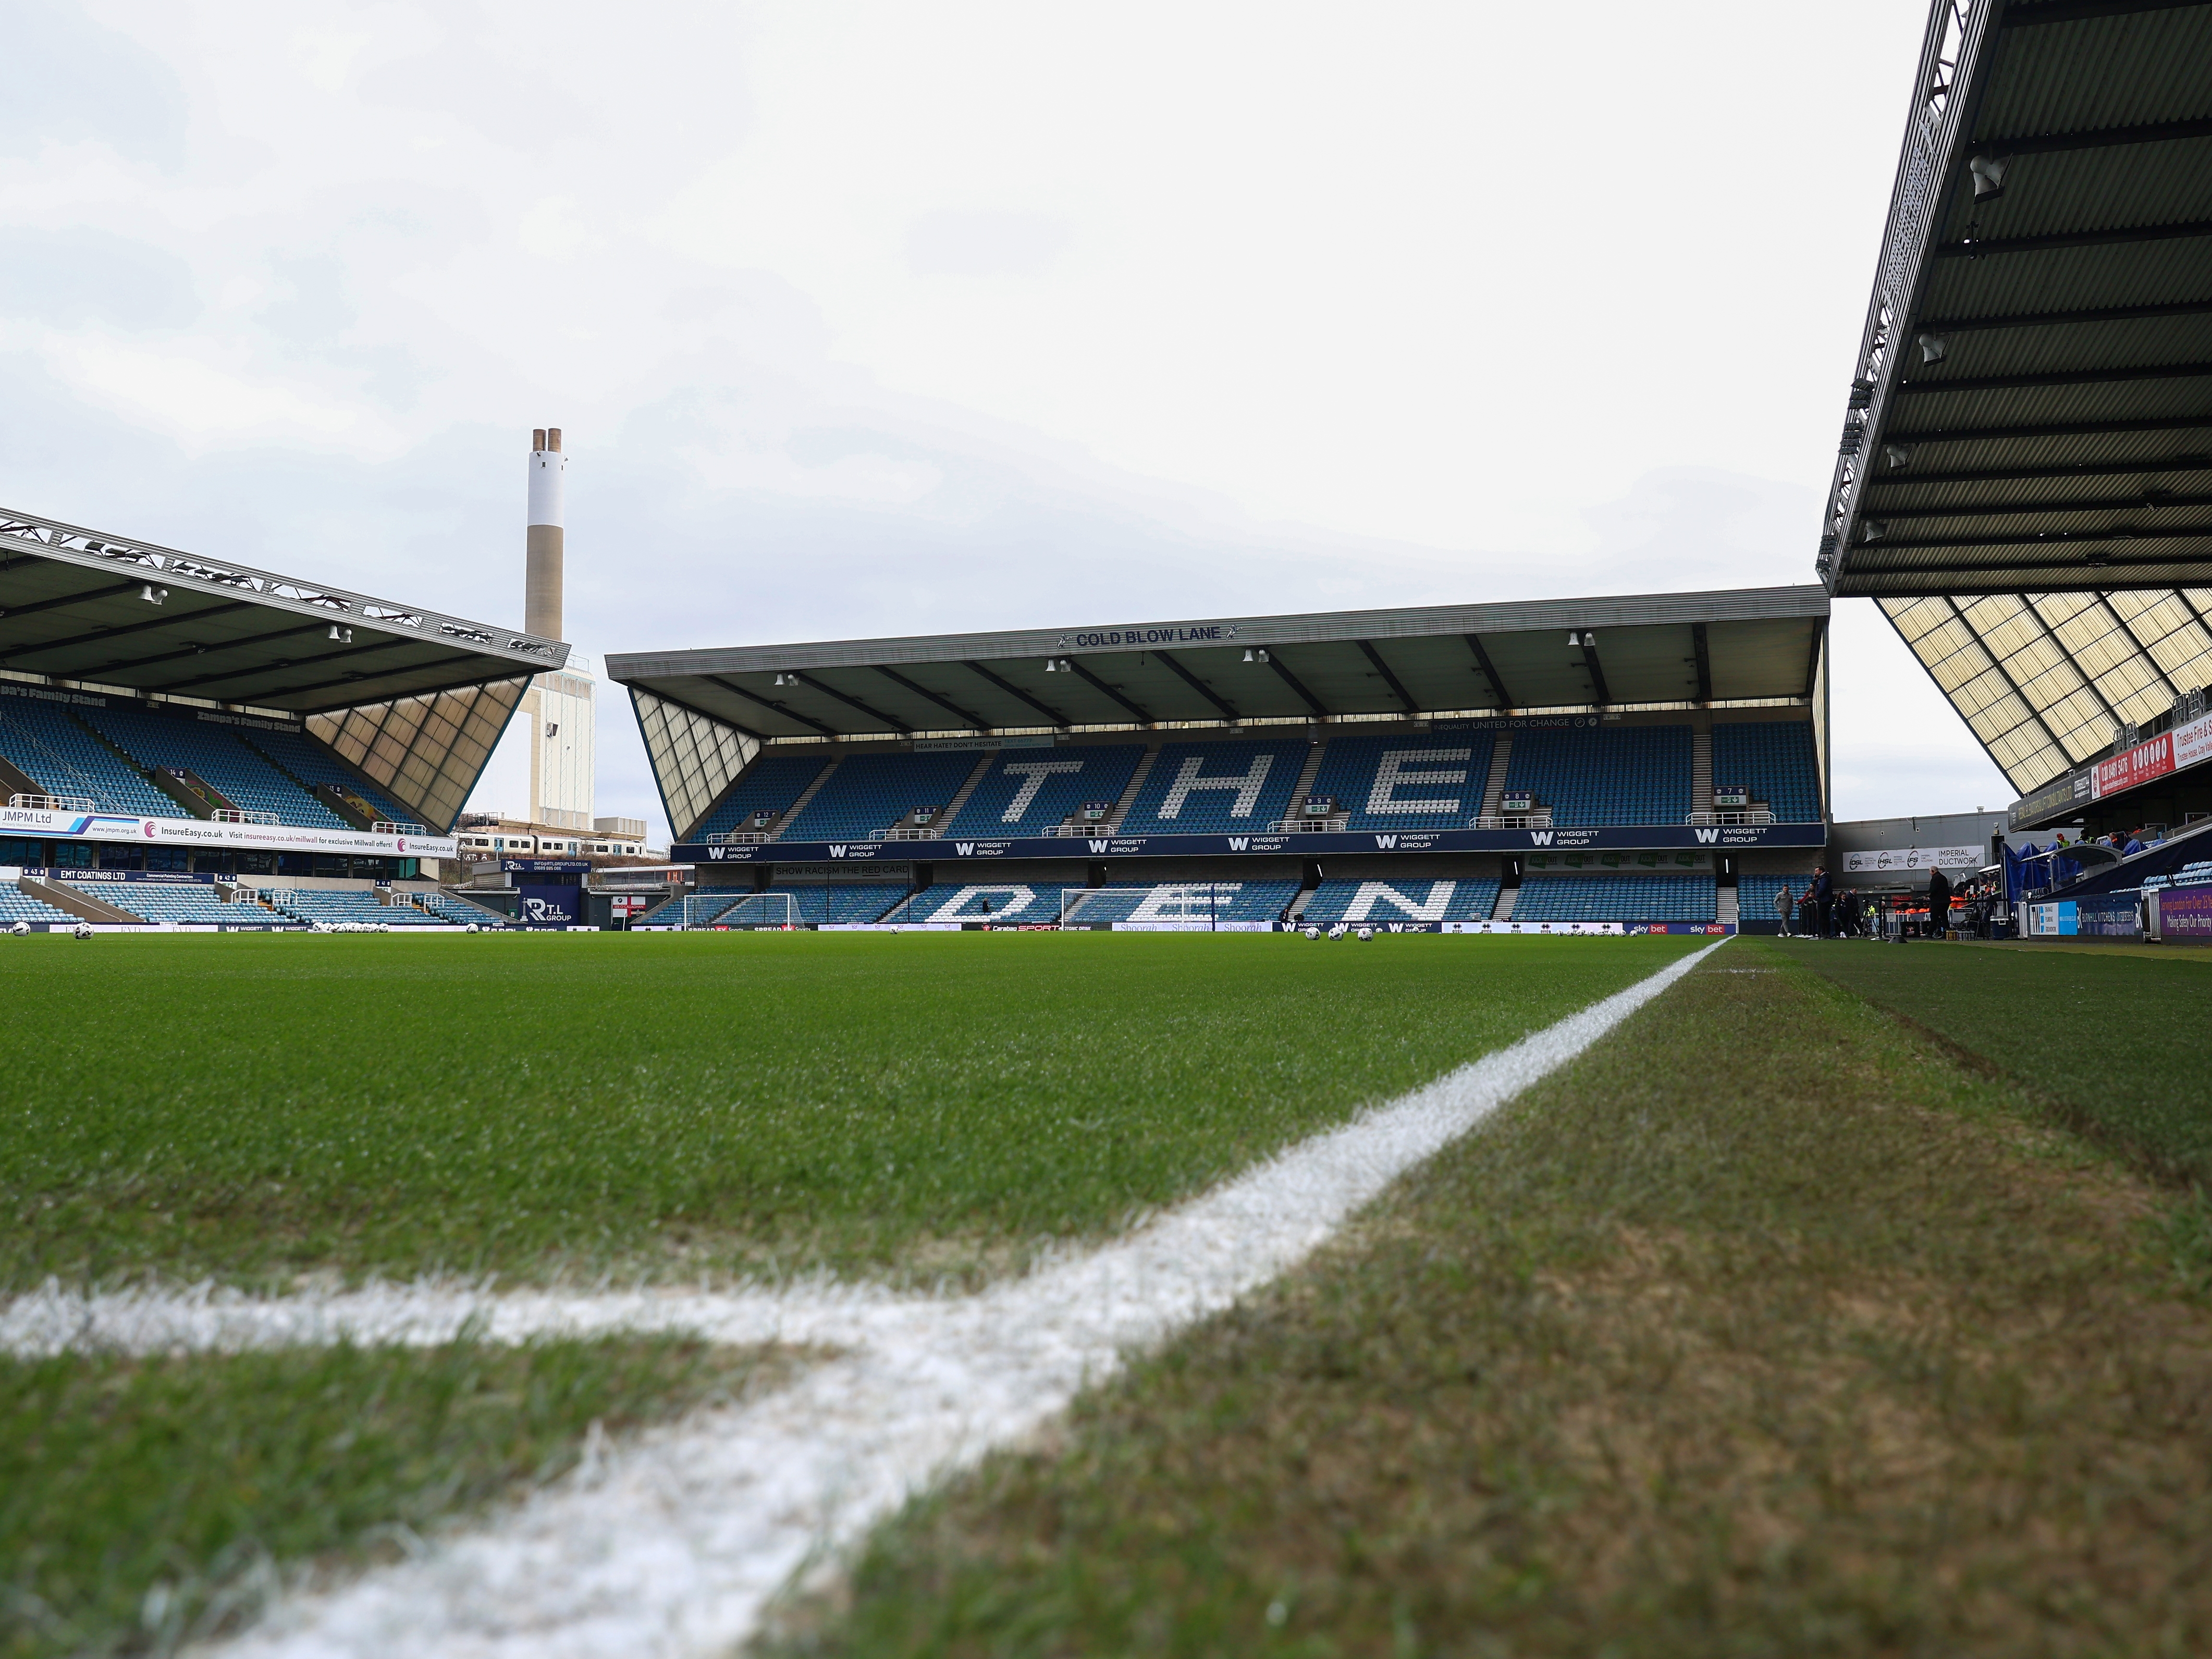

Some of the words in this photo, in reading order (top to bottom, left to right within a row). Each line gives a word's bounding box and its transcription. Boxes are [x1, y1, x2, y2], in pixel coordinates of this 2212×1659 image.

[1077, 632, 1121, 646] COLD
[1125, 629, 1173, 644] BLOW
[1179, 626, 1222, 641] LANE
[29, 689, 71, 703] Family
[71, 694, 106, 707] Stand
[197, 711, 240, 725] Zampa's
[241, 718, 273, 730] Family
[274, 722, 301, 733] Stand
[1530, 719, 1569, 727] CHANGE
[2177, 731, 2193, 748] Trustee
[2194, 725, 2203, 741] Fire
[2204, 721, 2208, 738] &
[2118, 756, 2128, 776] 5476
[3, 811, 33, 822] JMPM
[36, 813, 51, 824] Ltd
[92, 827, 137, 835] www.jmpm.org.uk
[1695, 828, 1719, 843] W
[162, 827, 223, 839] InsureEasy.co.uk
[244, 834, 317, 844] insureeasy.co.uk/millwall
[410, 842, 453, 853] InsureEasy.co.uk
[1228, 837, 1249, 851] W
[1375, 834, 1397, 849] W
[1531, 831, 1554, 845] W
[708, 847, 725, 859] W
[829, 845, 847, 857] W
[955, 843, 975, 855] W
[1088, 840, 1108, 853] W
[1939, 857, 1977, 865] DUCTWORK
[61, 870, 76, 879] EMT
[77, 870, 112, 880] COATINGS
[113, 872, 126, 880] LTD
[2160, 898, 2172, 914] Serving
[2172, 898, 2185, 910] London
[2192, 895, 2202, 909] Over
[2203, 895, 2208, 909] 25
[2098, 912, 2115, 922] KITCHENS
[2167, 914, 2179, 932] Making
[2179, 914, 2189, 932] Safety
[2197, 913, 2212, 932] Priority
[1121, 924, 1158, 932] Shoorah
[1172, 924, 1210, 932] Shoorah
[1224, 924, 1263, 932] Shoorah
[1634, 925, 1648, 933] sky
[1690, 925, 1705, 934] sky
